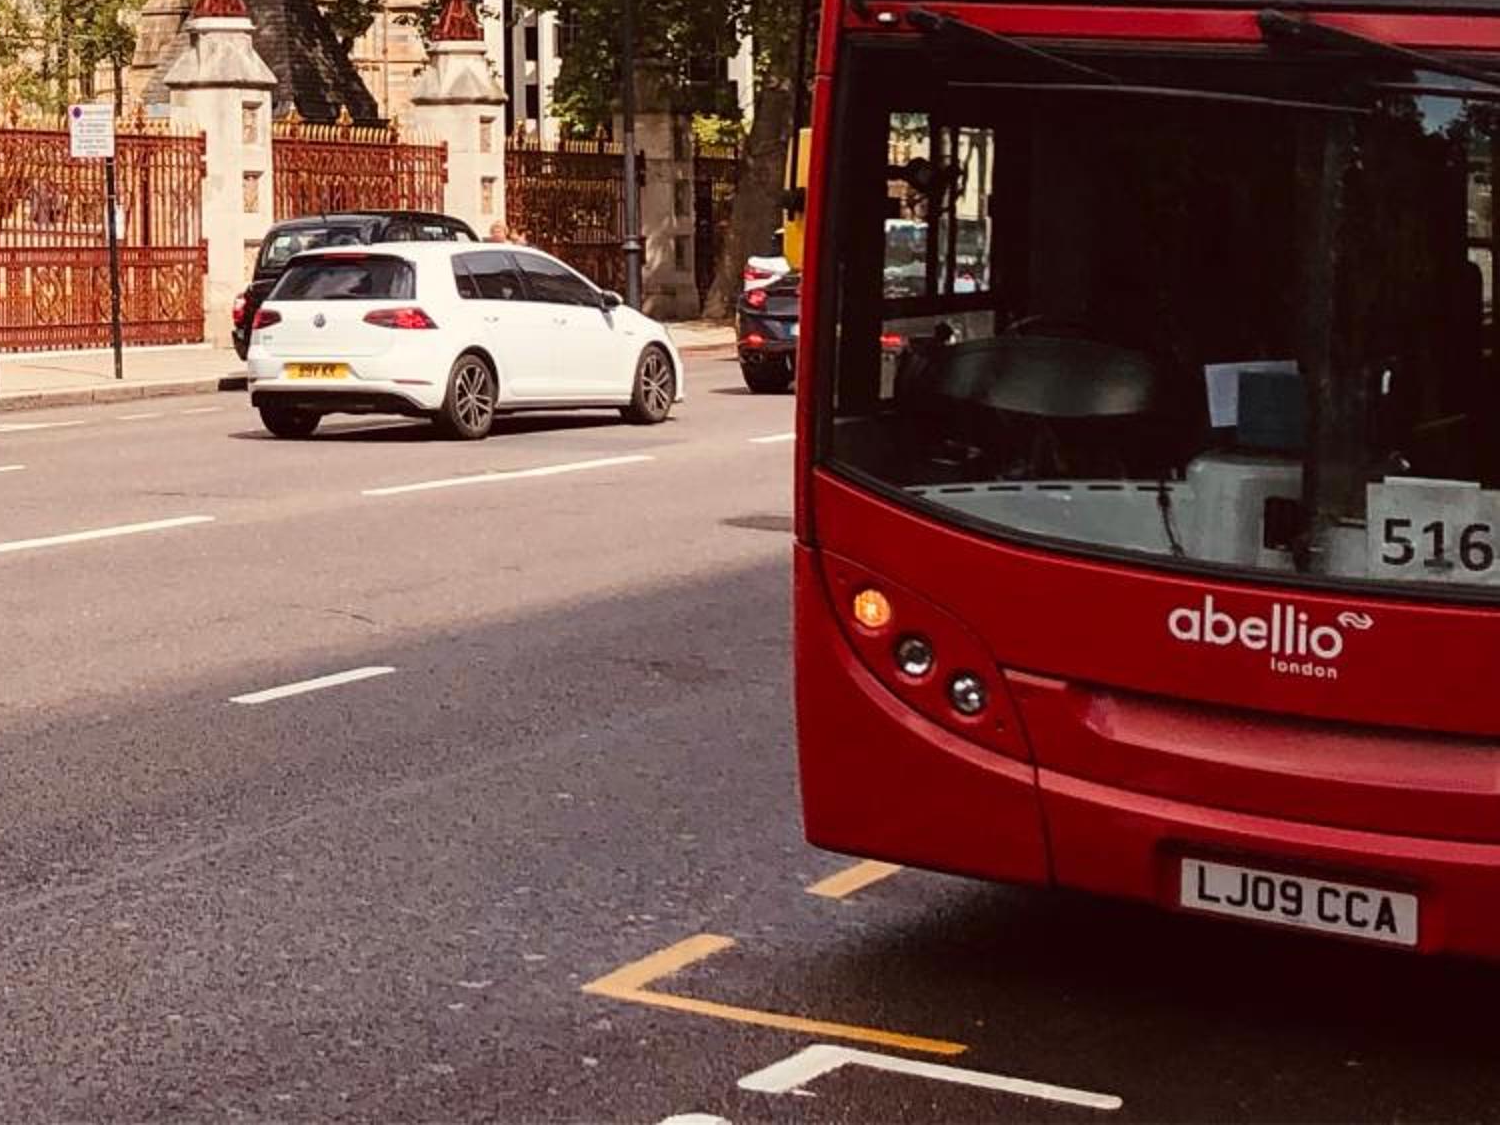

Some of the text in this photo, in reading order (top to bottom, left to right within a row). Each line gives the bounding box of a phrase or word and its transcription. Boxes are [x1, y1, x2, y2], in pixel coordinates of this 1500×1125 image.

[1381, 517, 1495, 572] 516
[1167, 594, 1344, 659] abellio
[1270, 657, 1337, 679] london
[1197, 866, 1398, 934] LJ09 CCA
